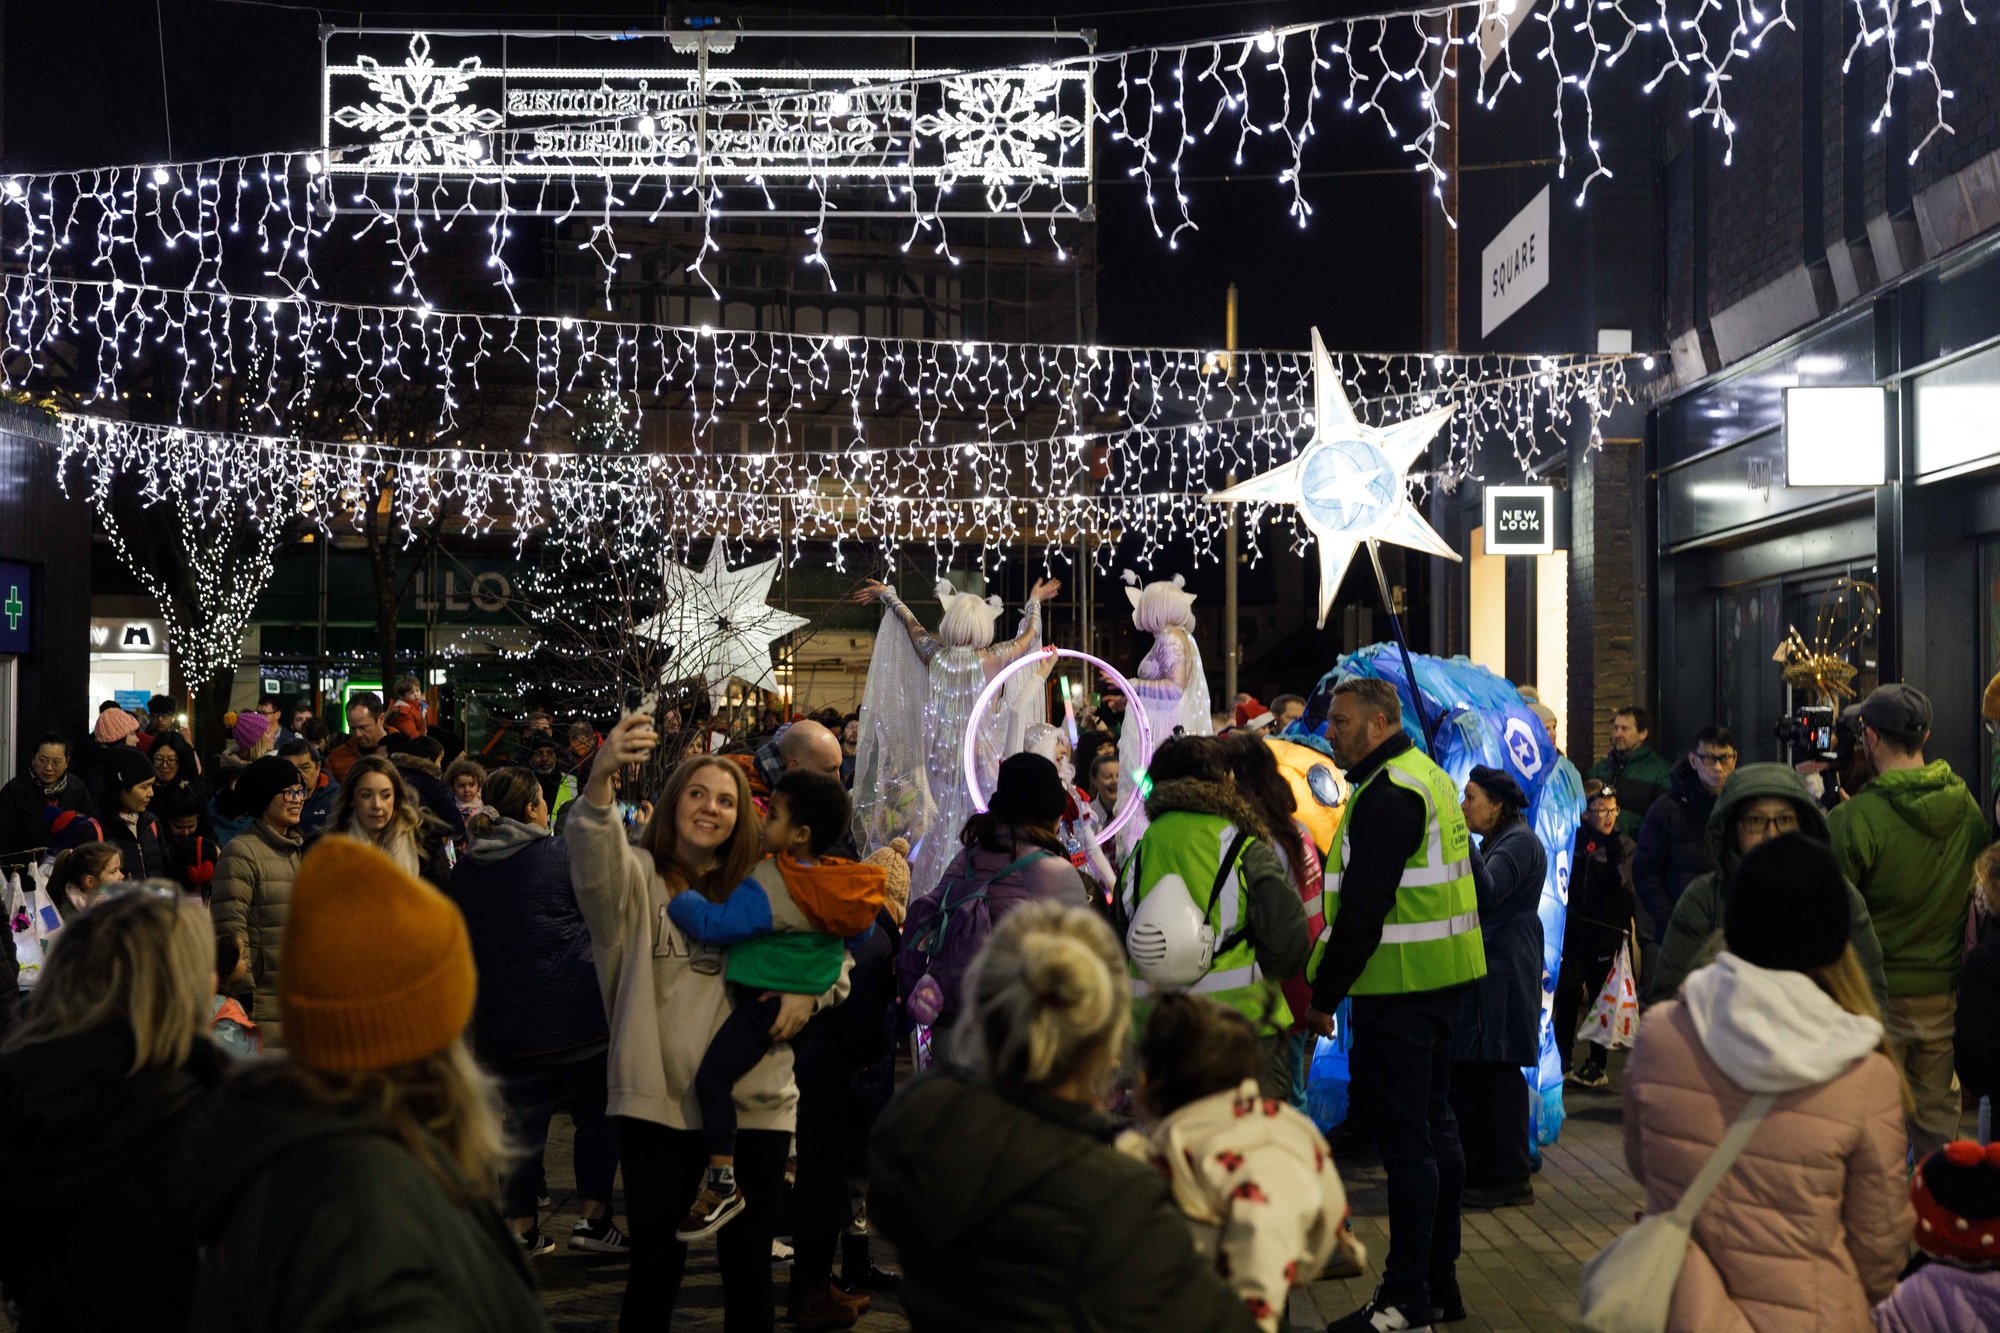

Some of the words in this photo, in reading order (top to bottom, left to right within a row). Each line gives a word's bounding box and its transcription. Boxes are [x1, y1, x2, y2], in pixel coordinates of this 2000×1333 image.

[1492, 234, 1536, 297] SQUARE
[1499, 519, 1540, 531] LOOK
[1502, 509, 1537, 521] NEW
[415, 570, 530, 613] LLO
